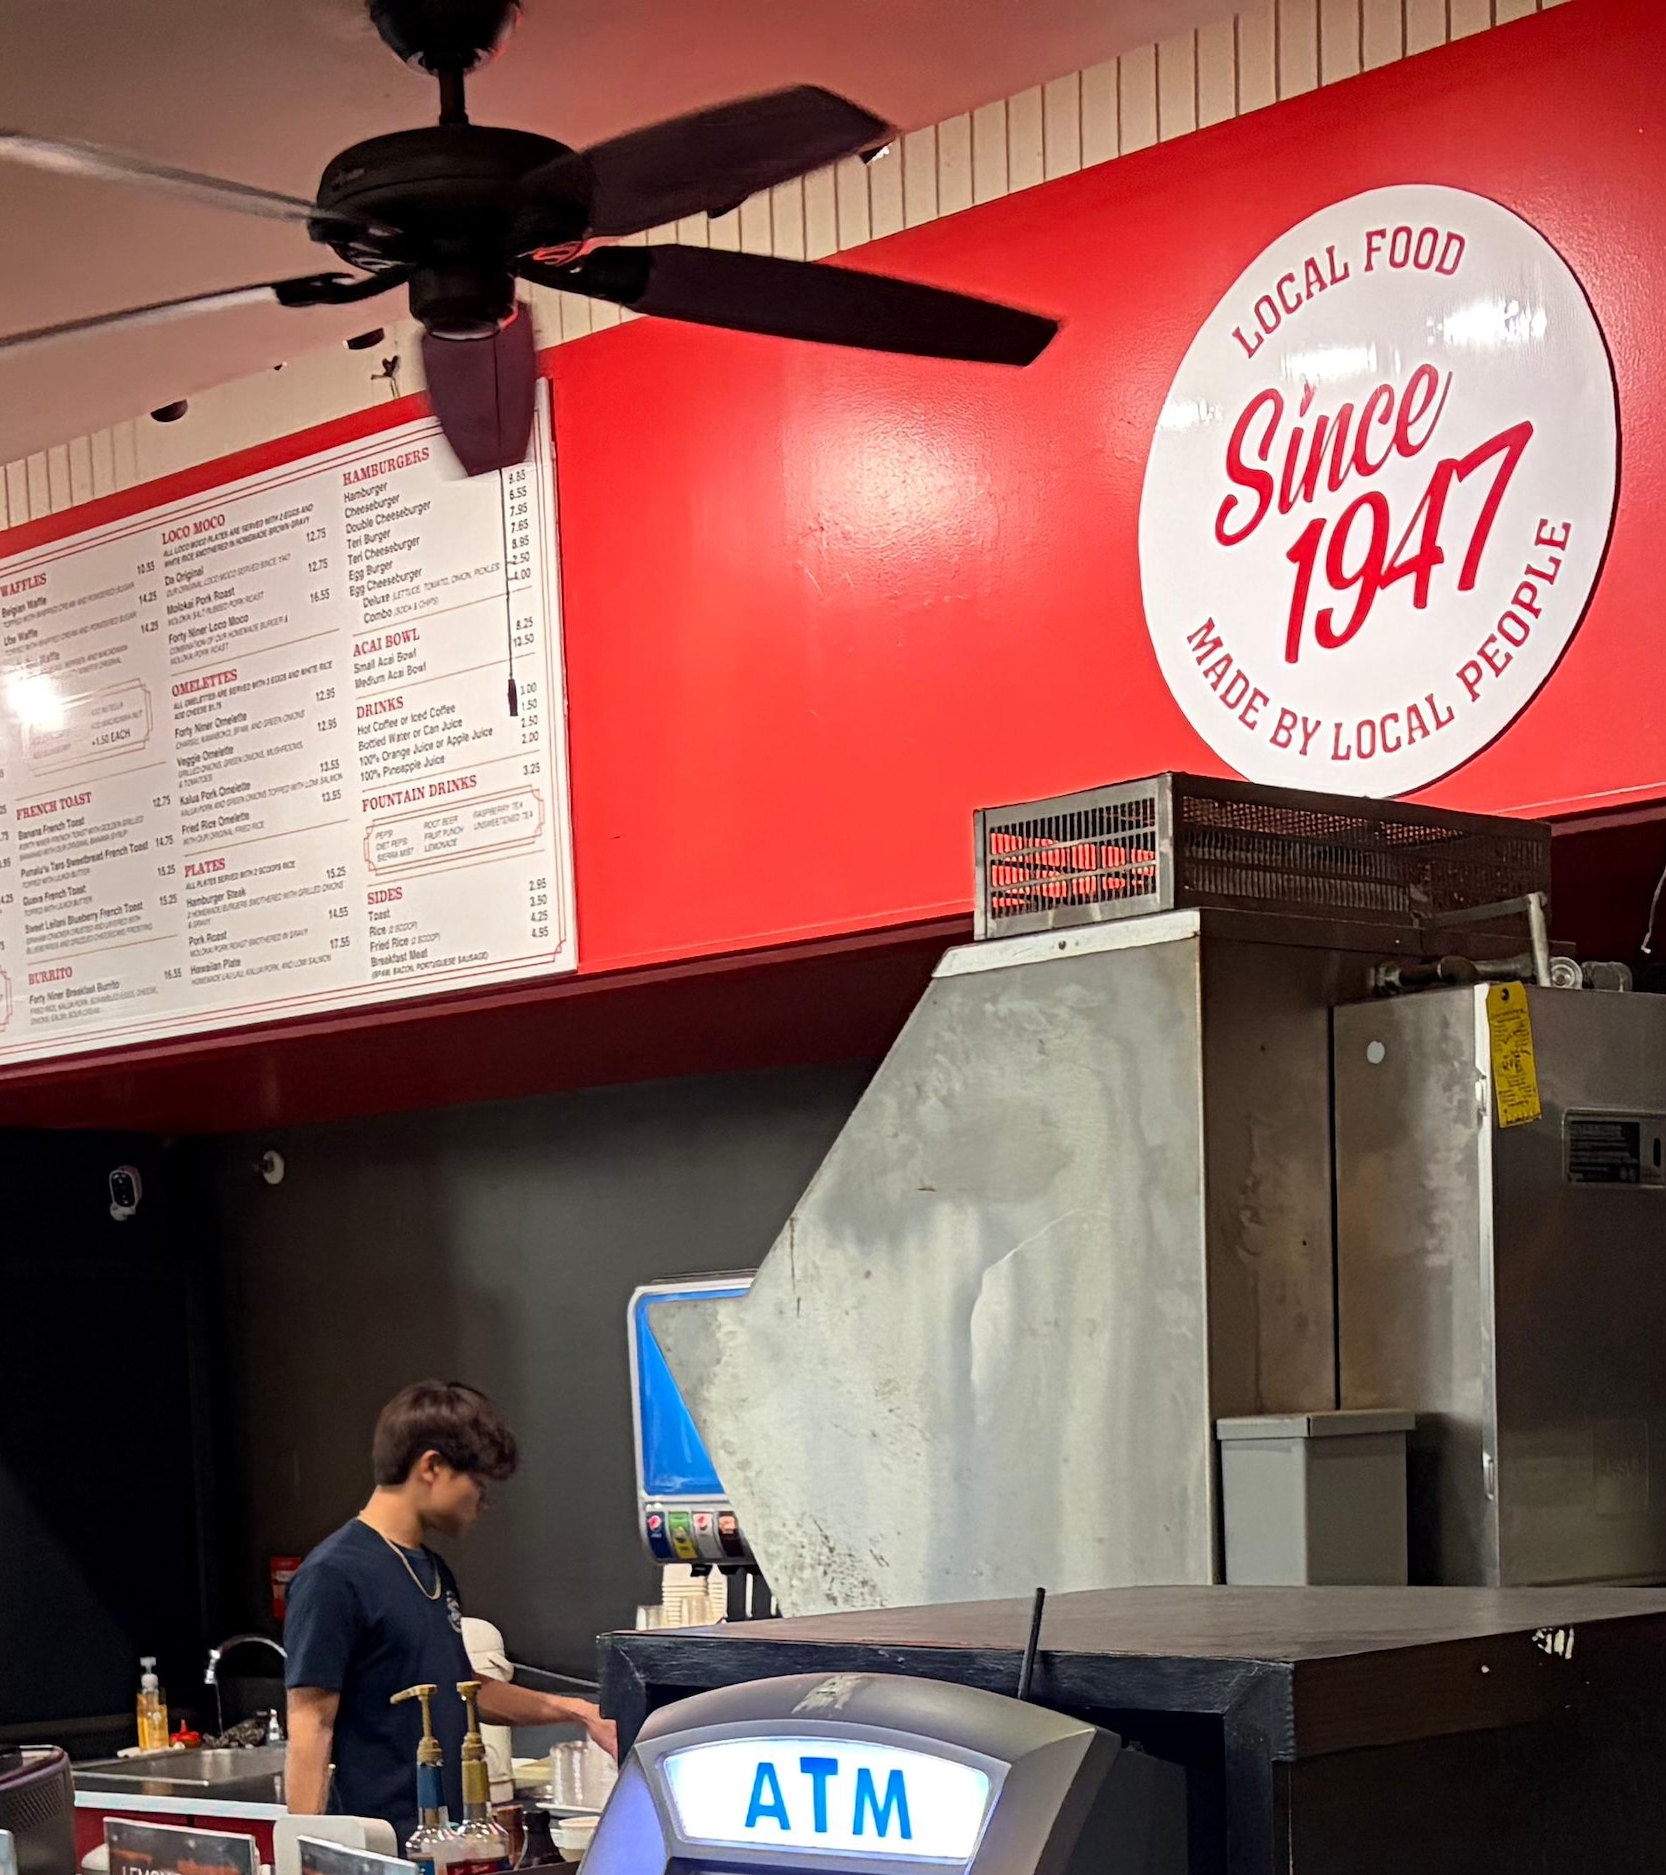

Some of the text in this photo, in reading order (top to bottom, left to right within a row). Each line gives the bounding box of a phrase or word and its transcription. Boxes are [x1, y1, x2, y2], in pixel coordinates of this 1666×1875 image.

[1232, 225, 1466, 360] LOCAL FOOD
[343, 447, 429, 486] HAMBURGERS
[1214, 361, 1454, 547] Since
[344, 482, 388, 502] Hamburger
[345, 493, 400, 519] Cheeseburger
[346, 500, 527, 534] Double Cheeseburger 7.95
[162, 514, 326, 545] LOCO MOCO 12.75
[364, 529, 390, 546] Burger
[1285, 419, 1533, 664] 1947
[365, 536, 420, 560] Cheeseburger
[176, 566, 204, 582] Original
[308, 559, 328, 572] 12.75
[349, 560, 393, 582] Egg Burger
[350, 568, 422, 599] Egg Cheeseburger
[0, 573, 47, 598] WAFFLES
[364, 608, 392, 624] Combo
[353, 628, 420, 657] ACAI BOWL
[1186, 517, 1572, 762] MADE BY LOCAL PEOPLE
[354, 658, 375, 674] Small
[397, 648, 417, 664] Bowl
[172, 669, 238, 698] OMELETTES
[357, 697, 403, 719] DRINKS
[358, 704, 455, 736] Hot Coffee or Iced Coffee
[361, 732, 539, 782] 100% Pineapple Juice 2.00
[17, 792, 92, 820] FRENCH TOAST
[362, 786, 425, 812] FOUNTAIN
[429, 775, 477, 797] DRINKS
[184, 858, 225, 878] PLATES
[367, 887, 403, 905] SIDES
[368, 909, 390, 922] Toast
[189, 934, 206, 946] Pork
[208, 930, 227, 941] Roast
[370, 937, 409, 952] Fried Rice
[28, 966, 73, 985] BURRITO
[745, 1757, 912, 1840] ATM
